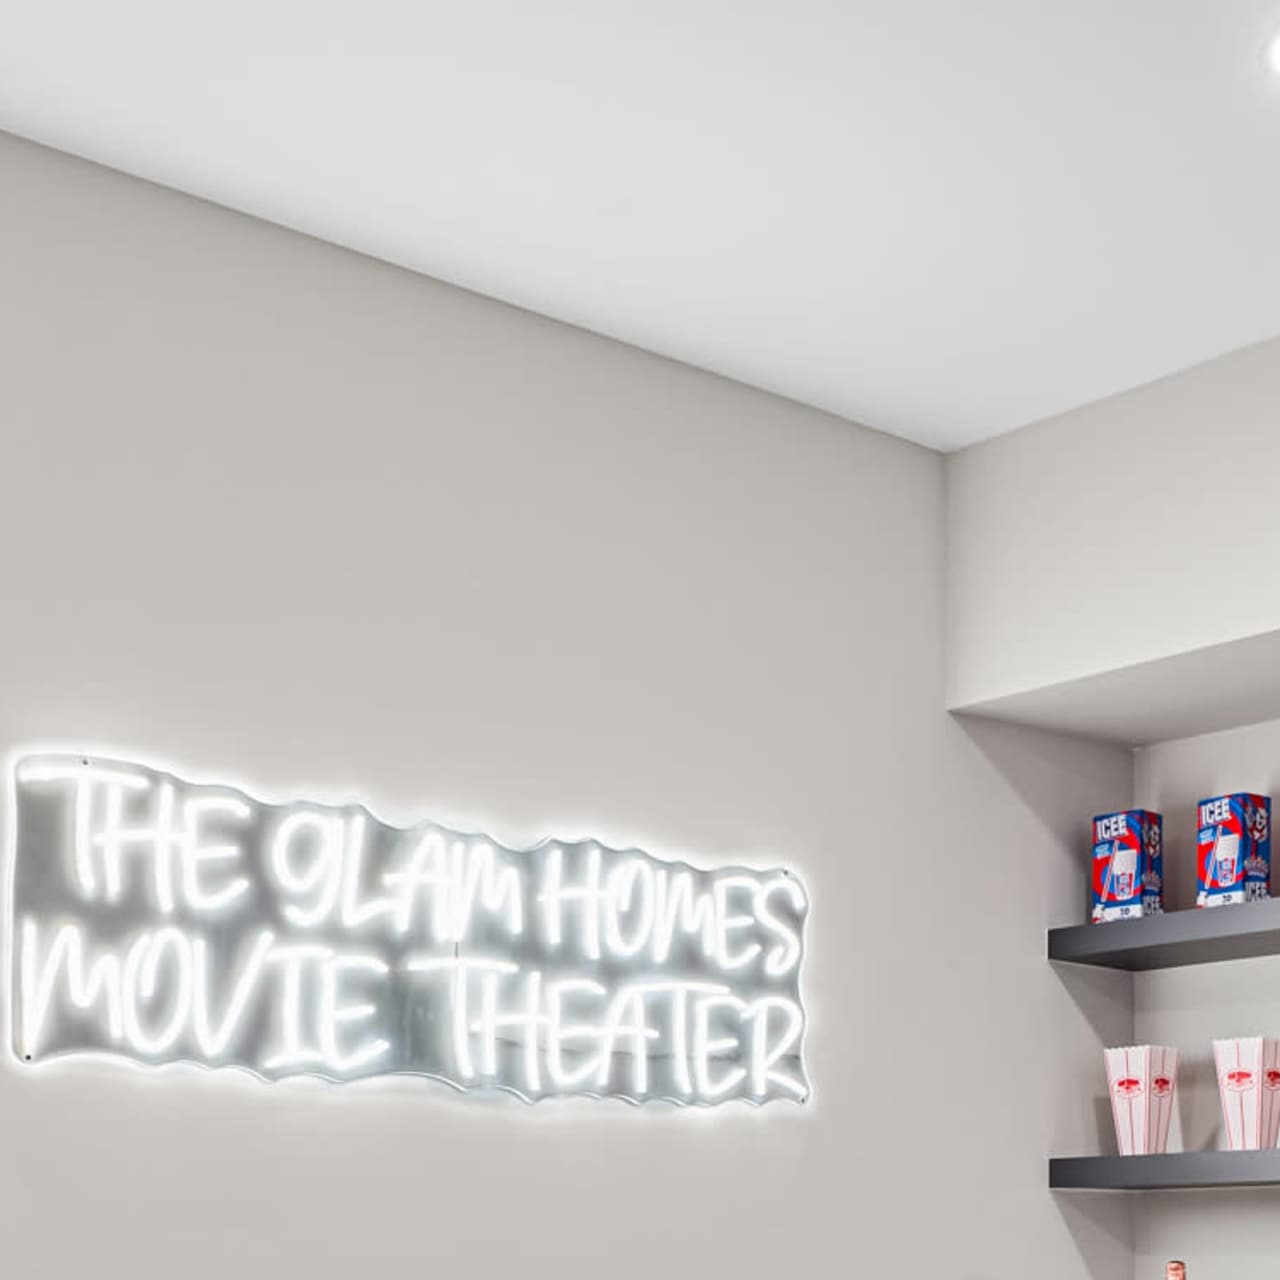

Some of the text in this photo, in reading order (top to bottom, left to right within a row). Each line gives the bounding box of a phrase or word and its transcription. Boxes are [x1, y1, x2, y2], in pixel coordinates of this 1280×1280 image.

[1096, 814, 1128, 841] ICEE
[1201, 798, 1232, 826] ICEE
[18, 766, 252, 914] THE
[538, 844, 809, 976] HOMES
[21, 916, 810, 1097] MOVIE THEATER
